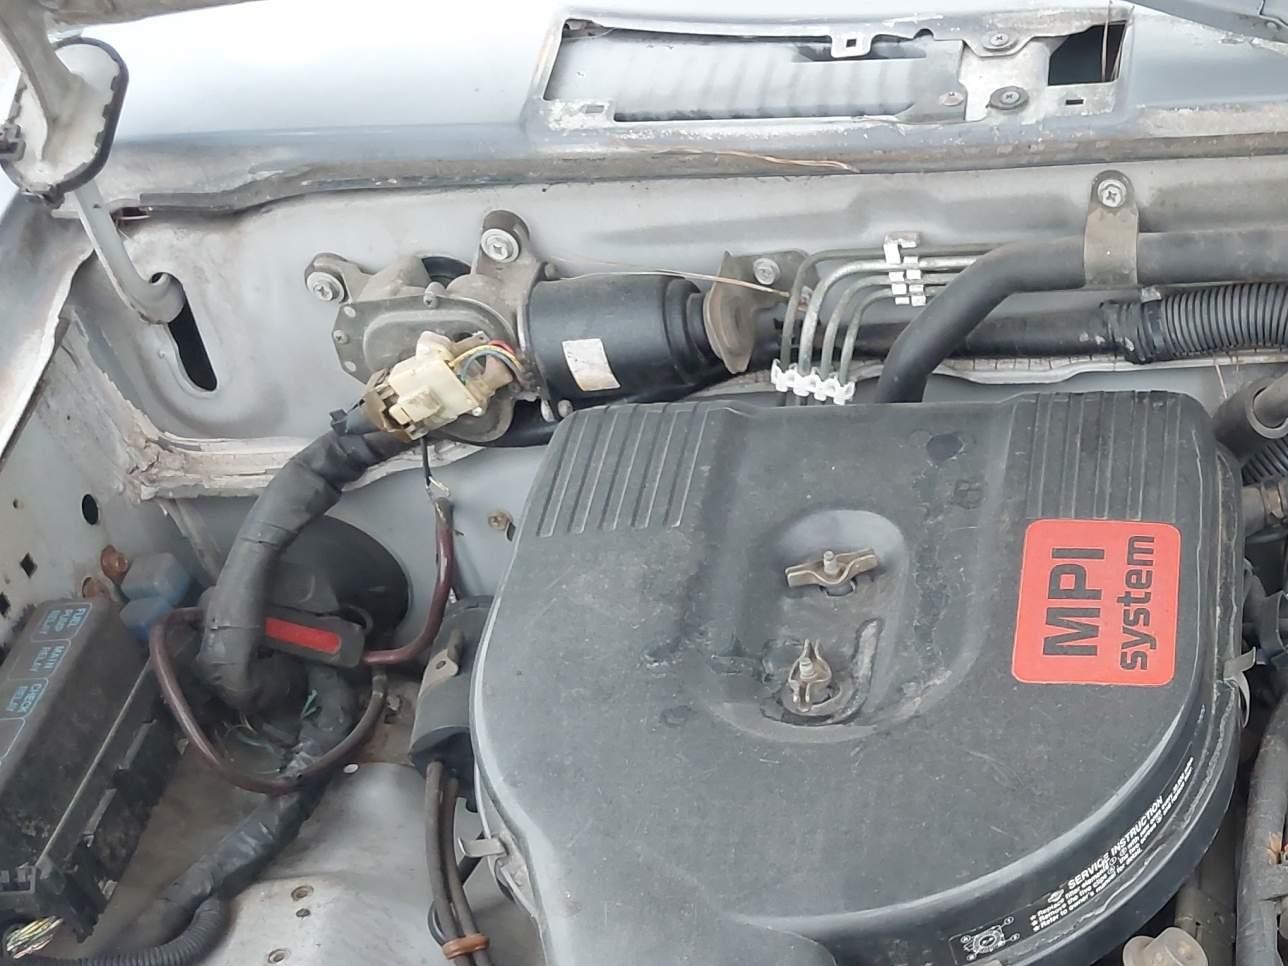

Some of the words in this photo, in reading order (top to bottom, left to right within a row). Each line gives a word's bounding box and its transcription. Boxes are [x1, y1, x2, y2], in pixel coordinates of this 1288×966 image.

[1043, 548, 1104, 656] MPI
[1117, 535, 1156, 670] system
[66, 608, 88, 628] FUEL
[43, 645, 65, 669] MAIN
[17, 683, 42, 713] CHECK
[1067, 852, 1109, 889] SERVICE
[1111, 795, 1163, 856] INSTRUCTION
[1037, 898, 1065, 917] Replace
[1039, 903, 1067, 922] Remove
[1067, 894, 1079, 905] the
[1060, 908, 1068, 916] to
